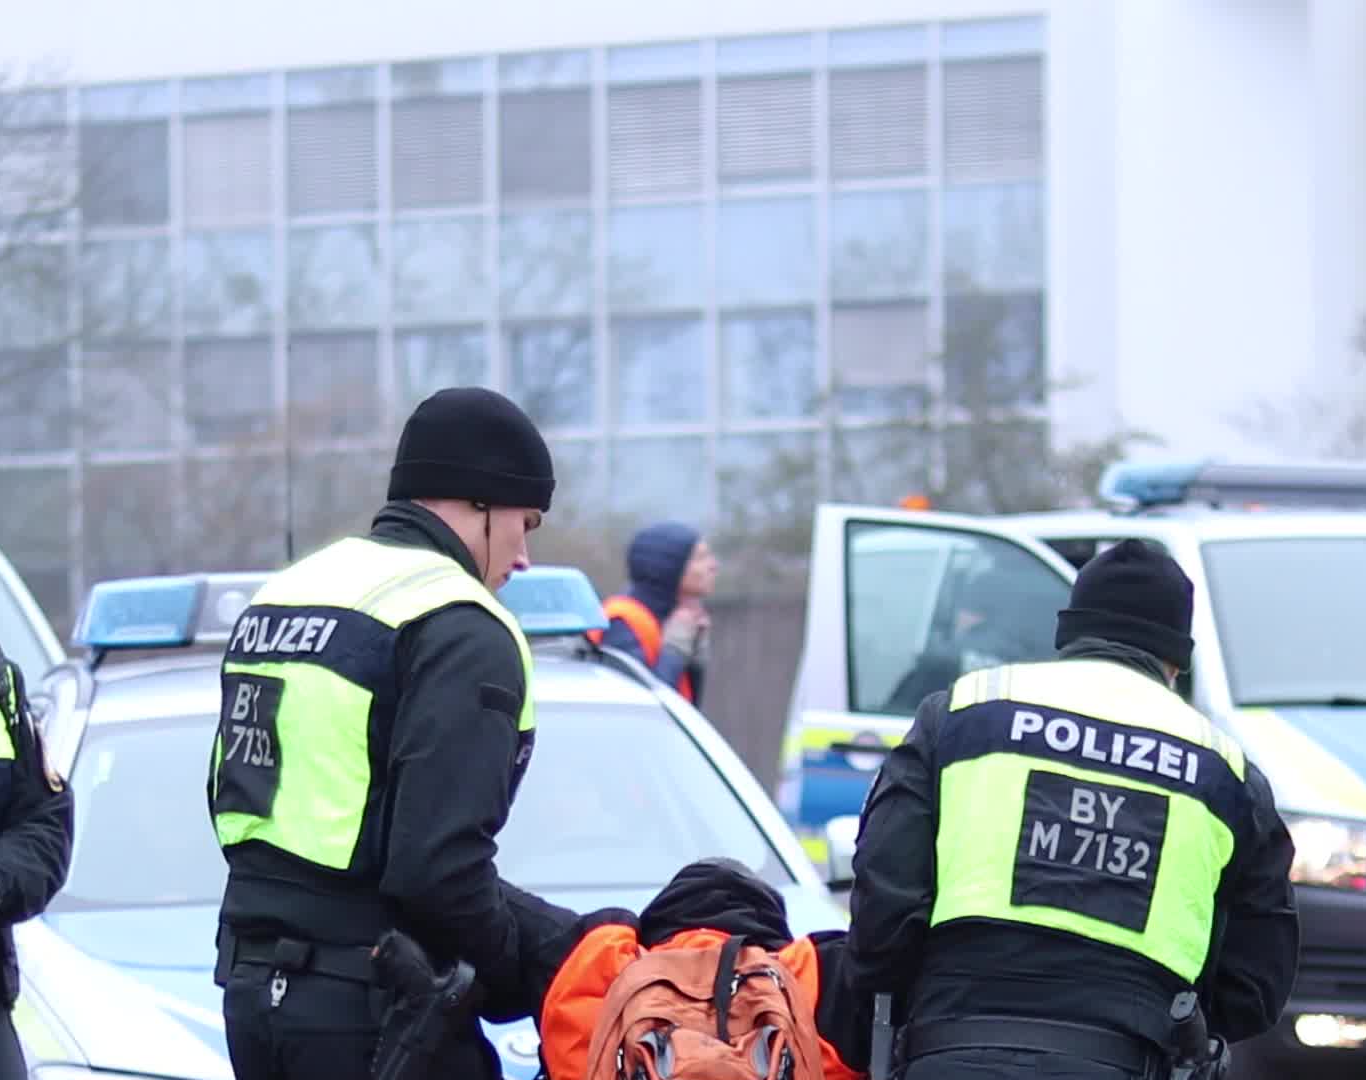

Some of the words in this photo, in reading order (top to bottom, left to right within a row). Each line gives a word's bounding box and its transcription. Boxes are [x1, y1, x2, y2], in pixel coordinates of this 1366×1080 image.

[231, 616, 338, 653] POLIZEI
[232, 683, 262, 722] BY
[225, 725, 275, 767] 7132
[1010, 710, 1199, 785] POLIZEI
[1070, 788, 1126, 830] BY
[1028, 820, 1062, 861] M
[1070, 828, 1150, 880] 7132
